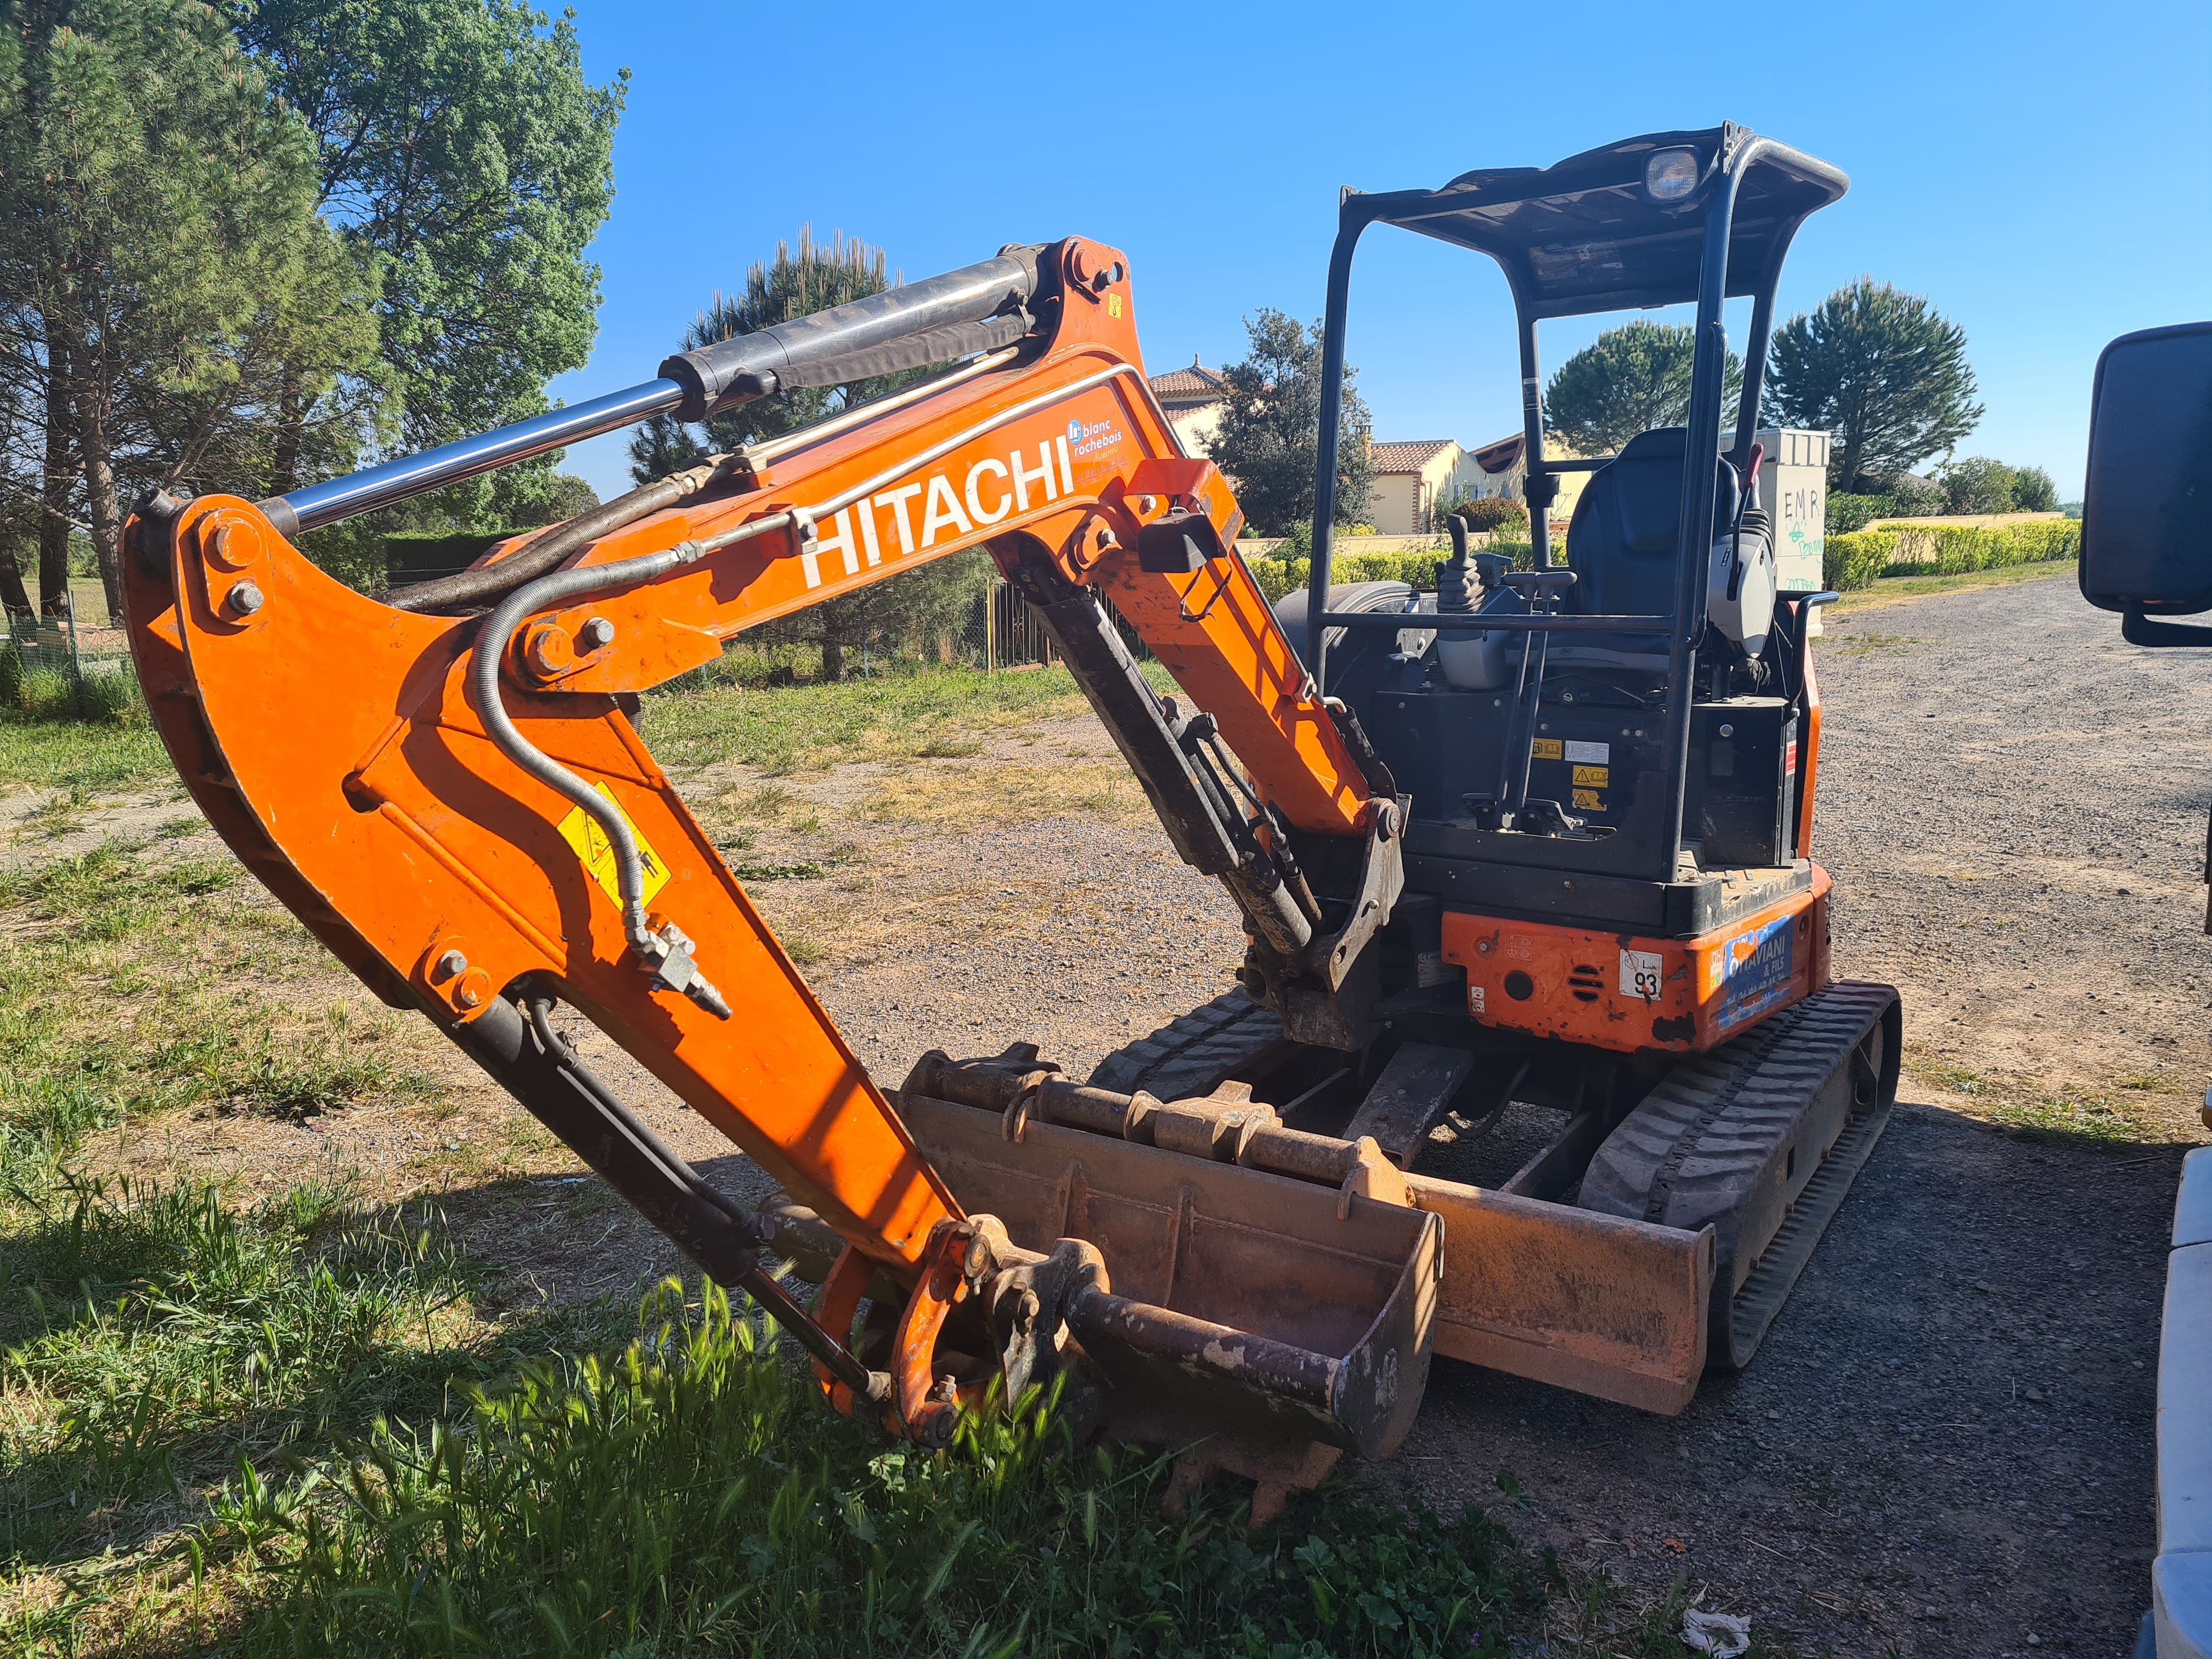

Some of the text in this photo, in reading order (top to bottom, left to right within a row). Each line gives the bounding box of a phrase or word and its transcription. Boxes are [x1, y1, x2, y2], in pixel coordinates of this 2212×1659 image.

[1083, 419, 1111, 438] blanc
[1074, 428, 1122, 458] rochebois
[802, 434, 1074, 589] HITACHI
[1764, 963, 1770, 978] &
[1771, 956, 1785, 974] FILS
[1635, 972, 1657, 996] 93
